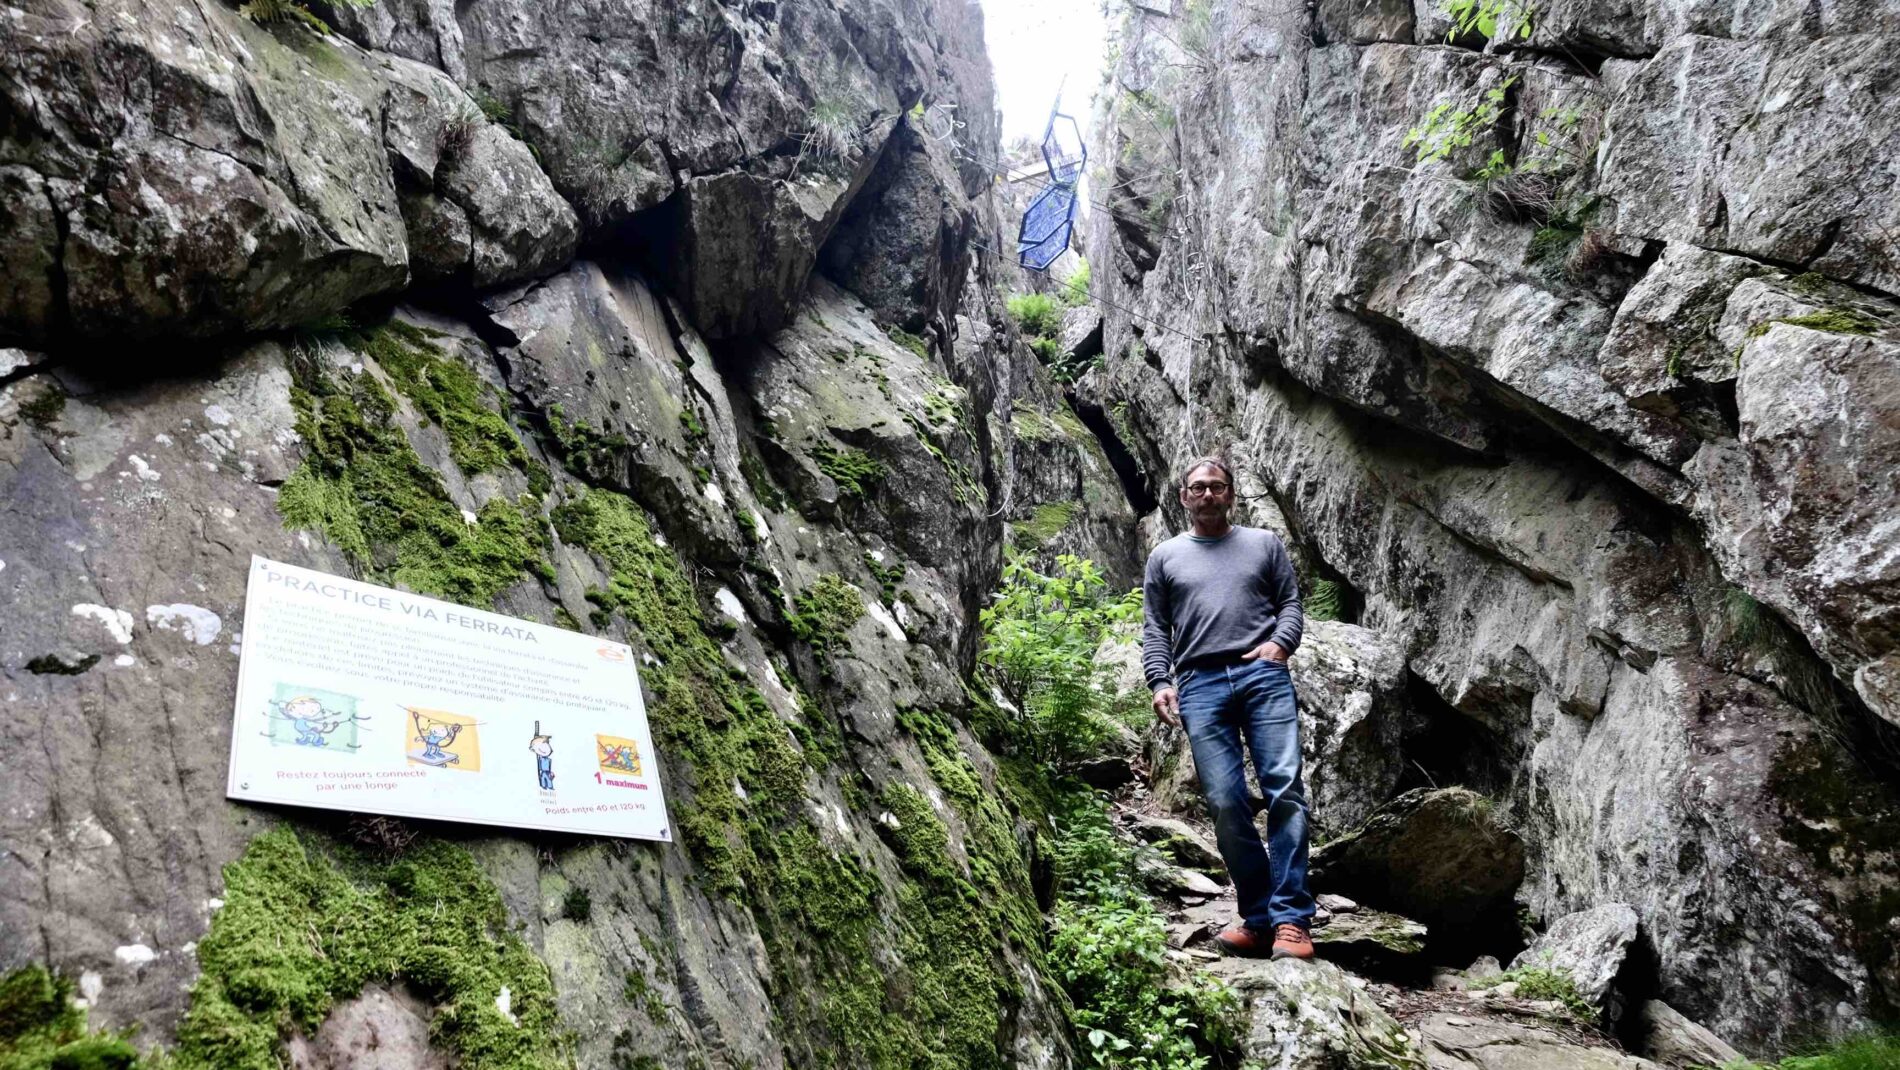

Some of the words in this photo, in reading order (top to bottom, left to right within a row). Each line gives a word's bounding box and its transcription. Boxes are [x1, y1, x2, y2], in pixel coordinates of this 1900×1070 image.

[267, 571, 392, 611] PRACTICE
[400, 601, 439, 621] VIA
[446, 612, 538, 643] FERRATA
[387, 657, 409, 666] pour
[559, 690, 579, 699] entre
[403, 679, 436, 690] propre
[276, 770, 318, 779] Restez
[323, 769, 373, 781] toujours
[375, 768, 427, 778] connecté
[594, 771, 602, 784] 1
[606, 779, 648, 790] maximum
[316, 784, 336, 793] par
[341, 782, 362, 790] une
[366, 780, 398, 791] longe
[545, 807, 570, 815] Poids
[572, 807, 594, 815] entre
[620, 803, 634, 811] 120
[636, 803, 646, 812] kg
